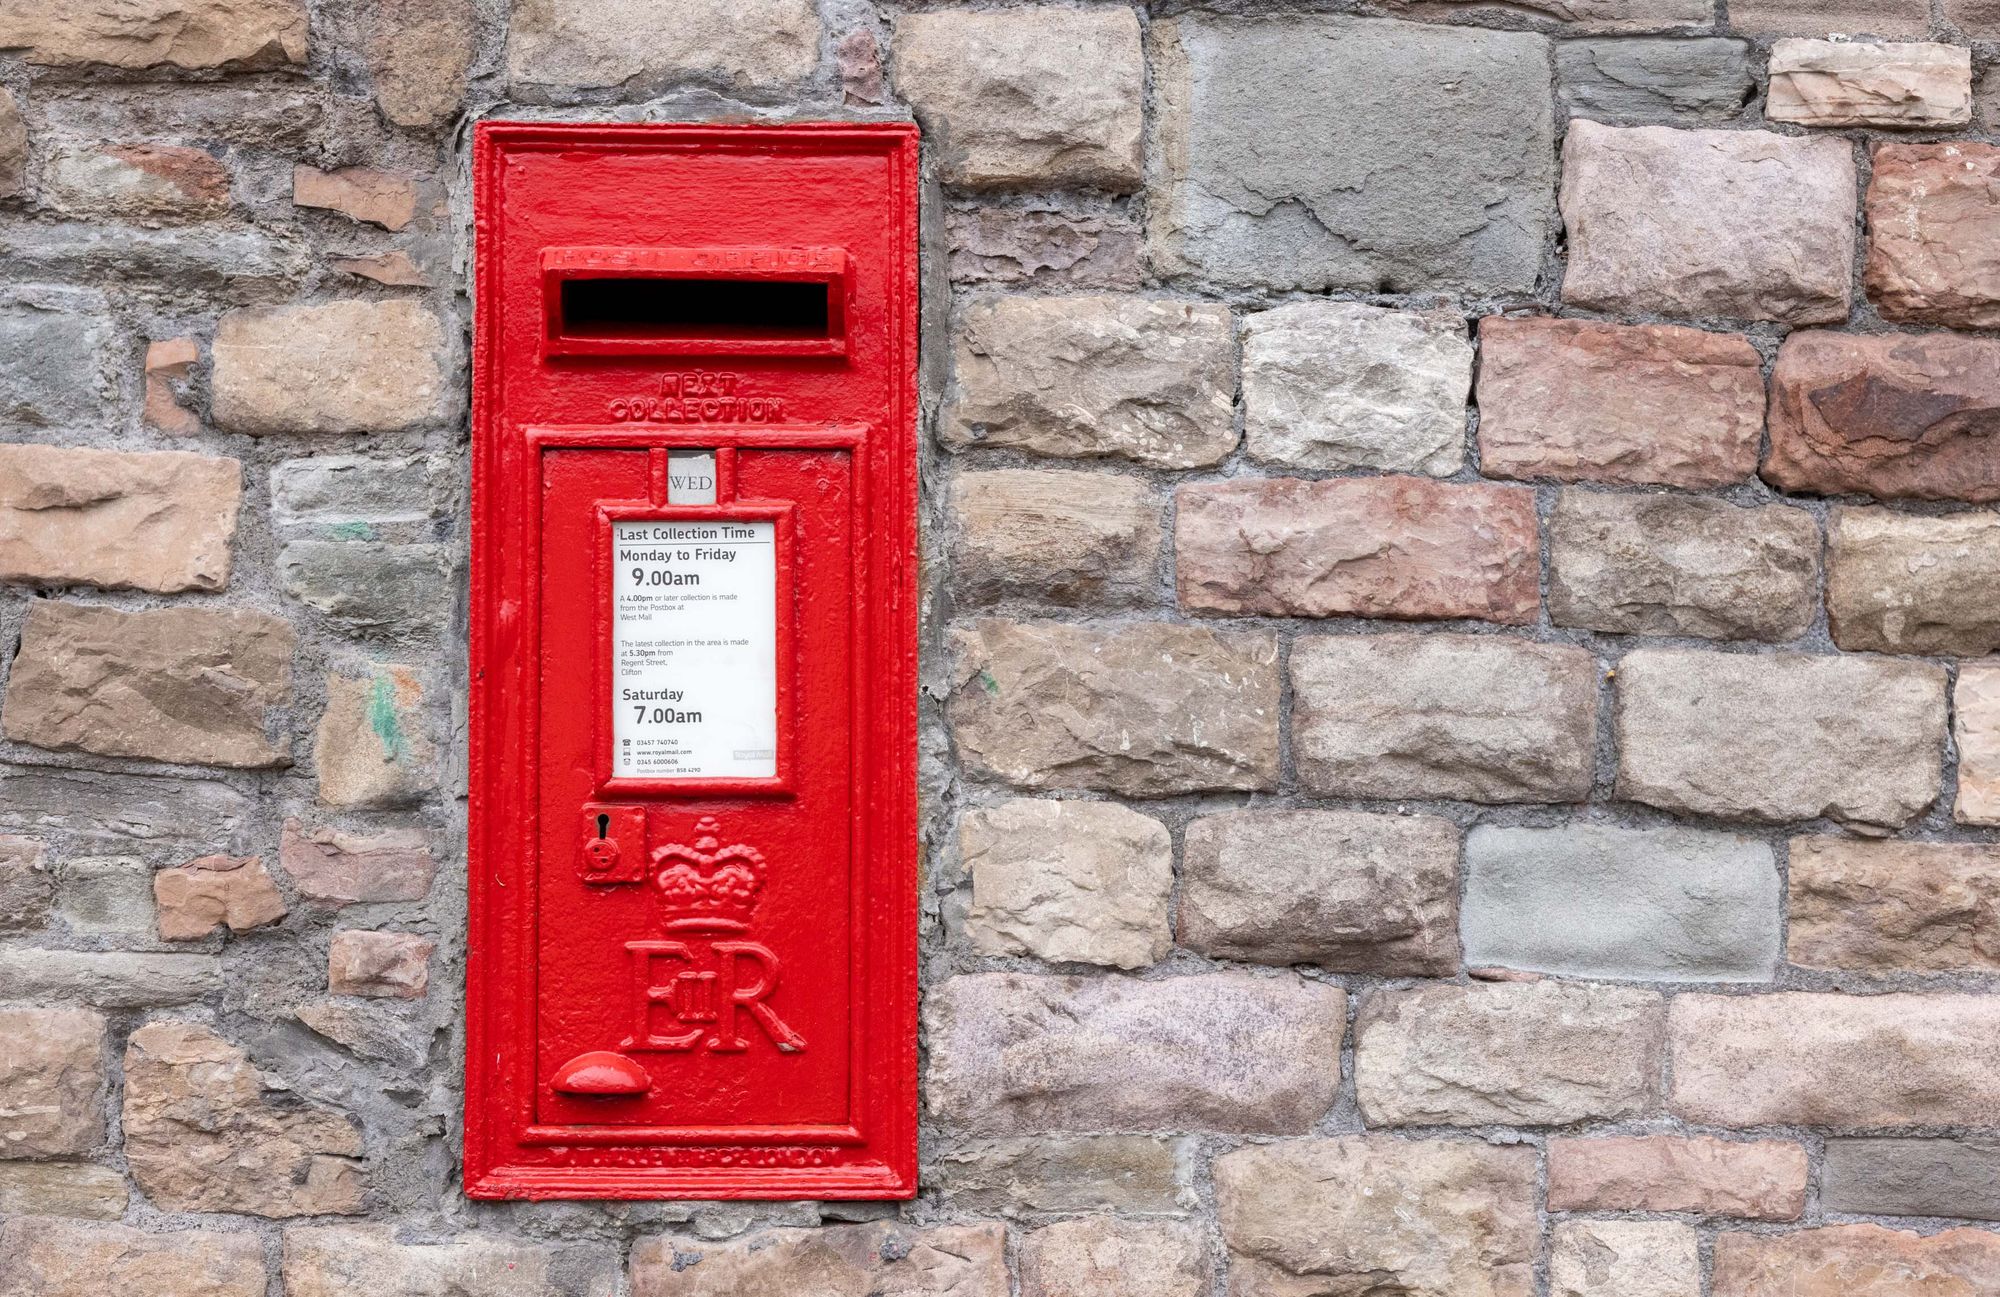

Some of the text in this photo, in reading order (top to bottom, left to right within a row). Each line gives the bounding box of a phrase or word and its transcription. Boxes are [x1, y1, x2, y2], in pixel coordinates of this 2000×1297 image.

[660, 372, 738, 397] NEXT
[609, 397, 785, 423] COLLECTION
[670, 476, 713, 490] WED
[619, 527, 755, 540] Last Collection Time
[620, 548, 737, 563] Monday to Friday
[631, 568, 700, 586] 9.00am
[626, 595, 653, 603] 4.00pm
[663, 594, 678, 602] later
[635, 639, 653, 647] latest
[655, 639, 685, 647] collection
[629, 649, 656, 657] 5.30pm
[621, 658, 668, 667] Regent Street,
[621, 668, 643, 676] Clifton
[622, 688, 684, 702] Saturday
[633, 706, 703, 724] 7.00am
[636, 748, 693, 757] www.royalmail.com
